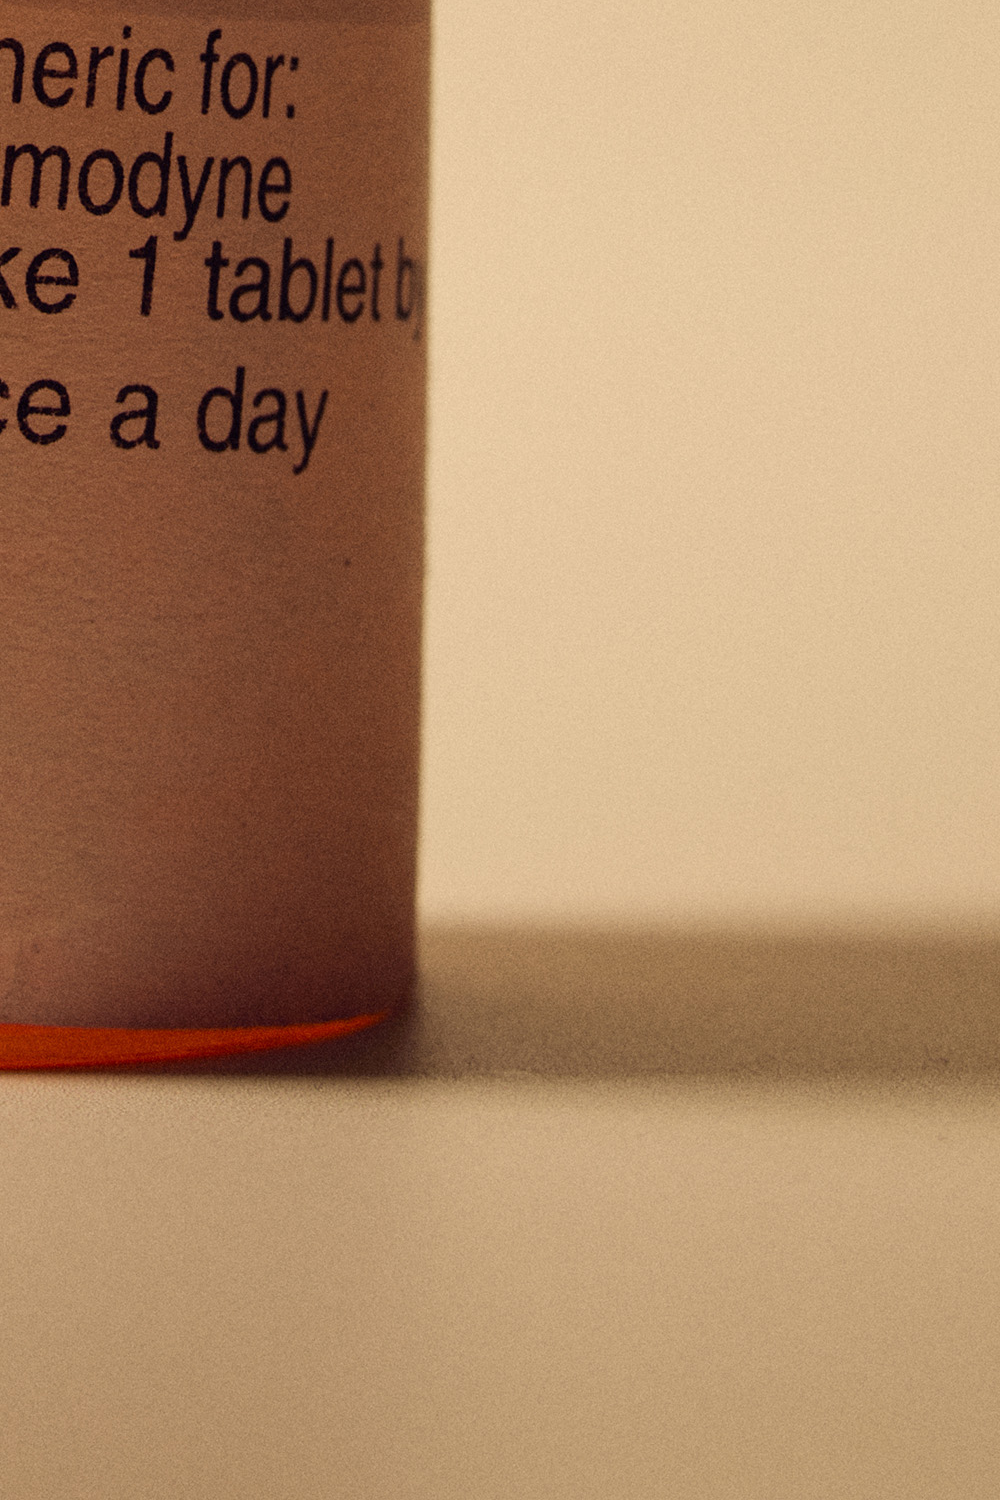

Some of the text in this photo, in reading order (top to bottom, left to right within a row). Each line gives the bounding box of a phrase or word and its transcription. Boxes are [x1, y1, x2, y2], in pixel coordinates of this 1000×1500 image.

[200, 28, 299, 120] for:
[128, 235, 158, 316] 1
[204, 236, 384, 324] tablet
[109, 383, 161, 451] a
[197, 366, 329, 476] day
